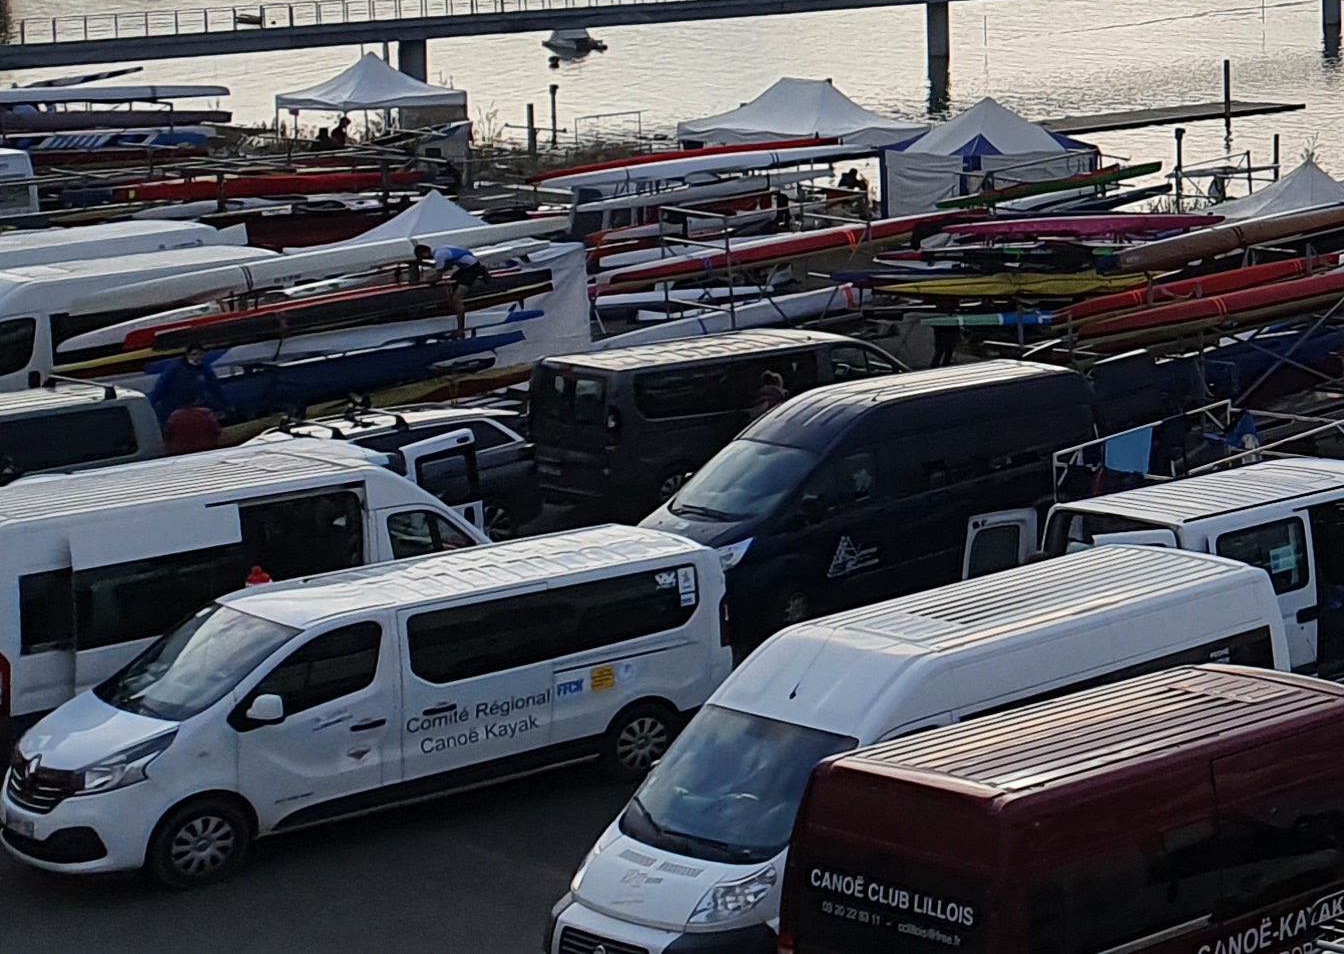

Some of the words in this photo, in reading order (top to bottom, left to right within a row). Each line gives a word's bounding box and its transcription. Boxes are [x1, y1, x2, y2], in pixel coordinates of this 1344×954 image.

[557, 679, 584, 696] FFCK
[406, 708, 470, 734] Comité
[475, 689, 551, 718] Régional
[420, 728, 480, 754] Canoë
[485, 715, 540, 740] Kayak
[810, 868, 865, 898] CANOË
[868, 883, 910, 909] CLUB
[914, 894, 974, 926] LILLOIS
[846, 907, 857, 920] 22
